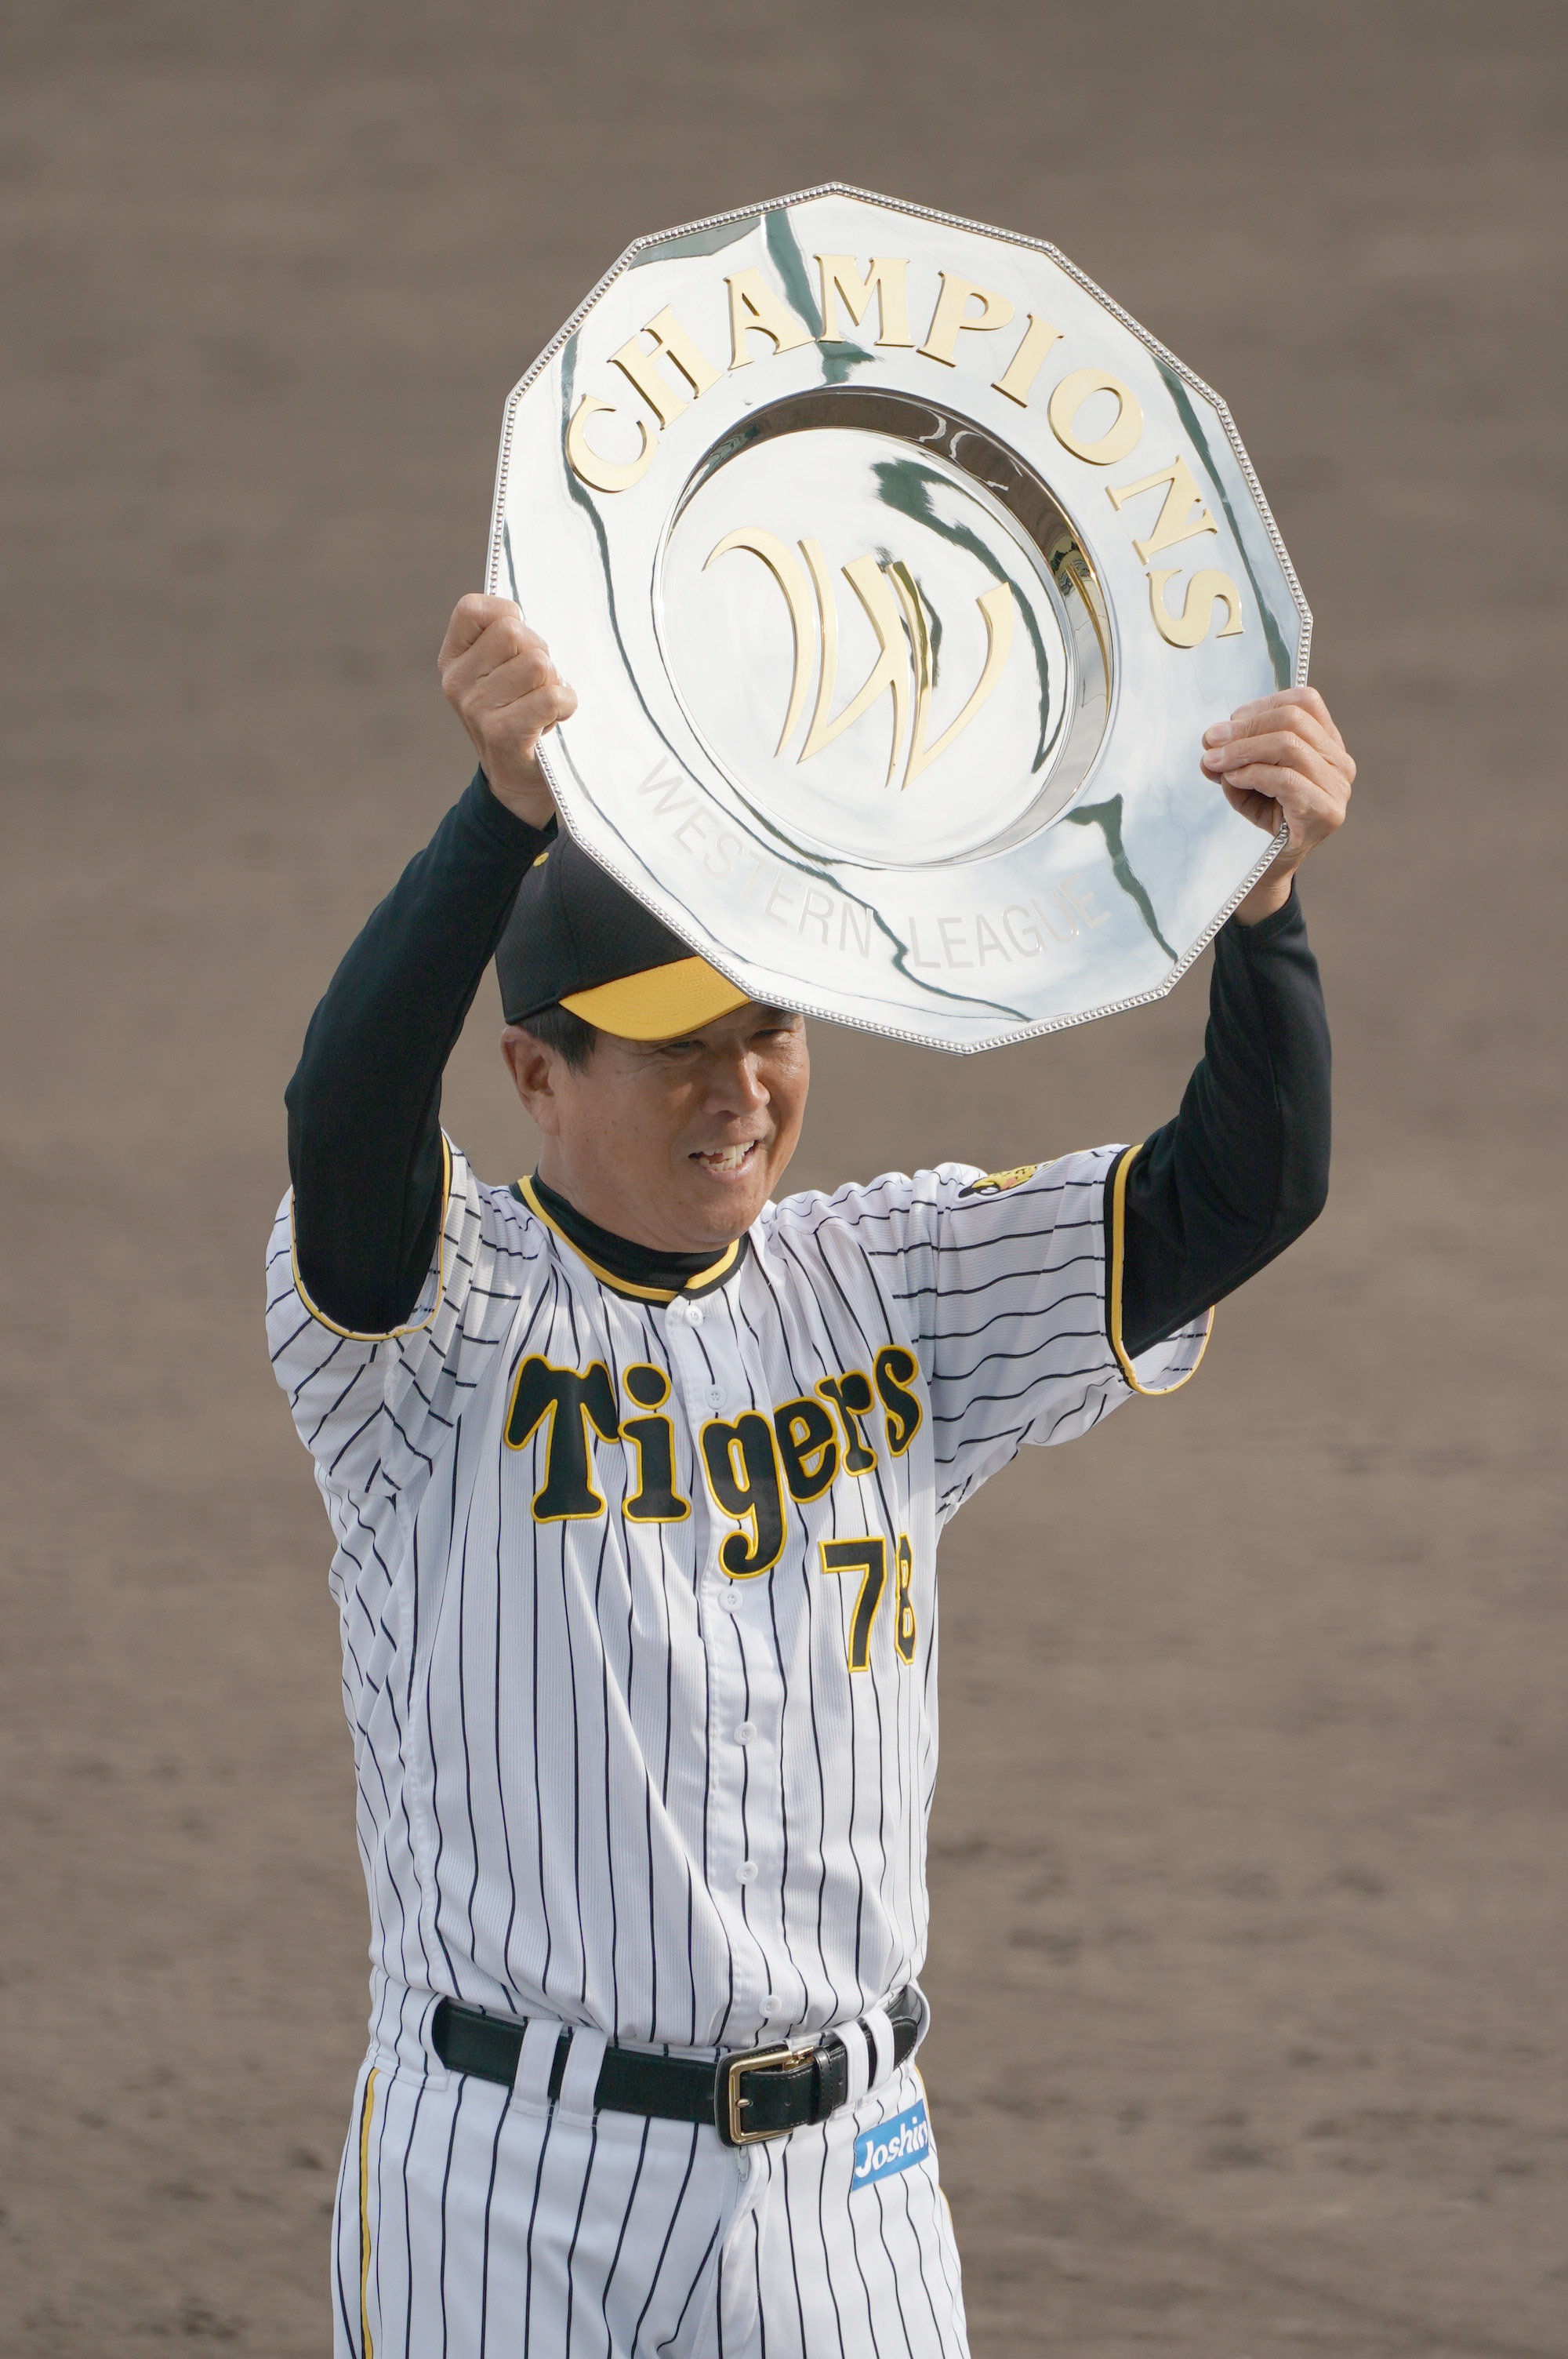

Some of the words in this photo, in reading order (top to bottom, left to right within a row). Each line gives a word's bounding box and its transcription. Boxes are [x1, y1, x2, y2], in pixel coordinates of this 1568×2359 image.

[564, 253, 1244, 649] CHAMPIONS
[637, 755, 874, 958] WESTERN
[909, 873, 1112, 969] LEAGUE
[504, 1346, 923, 1578] Tigers
[819, 1533, 915, 1672] 78
[855, 2116, 928, 2178] Joshin
